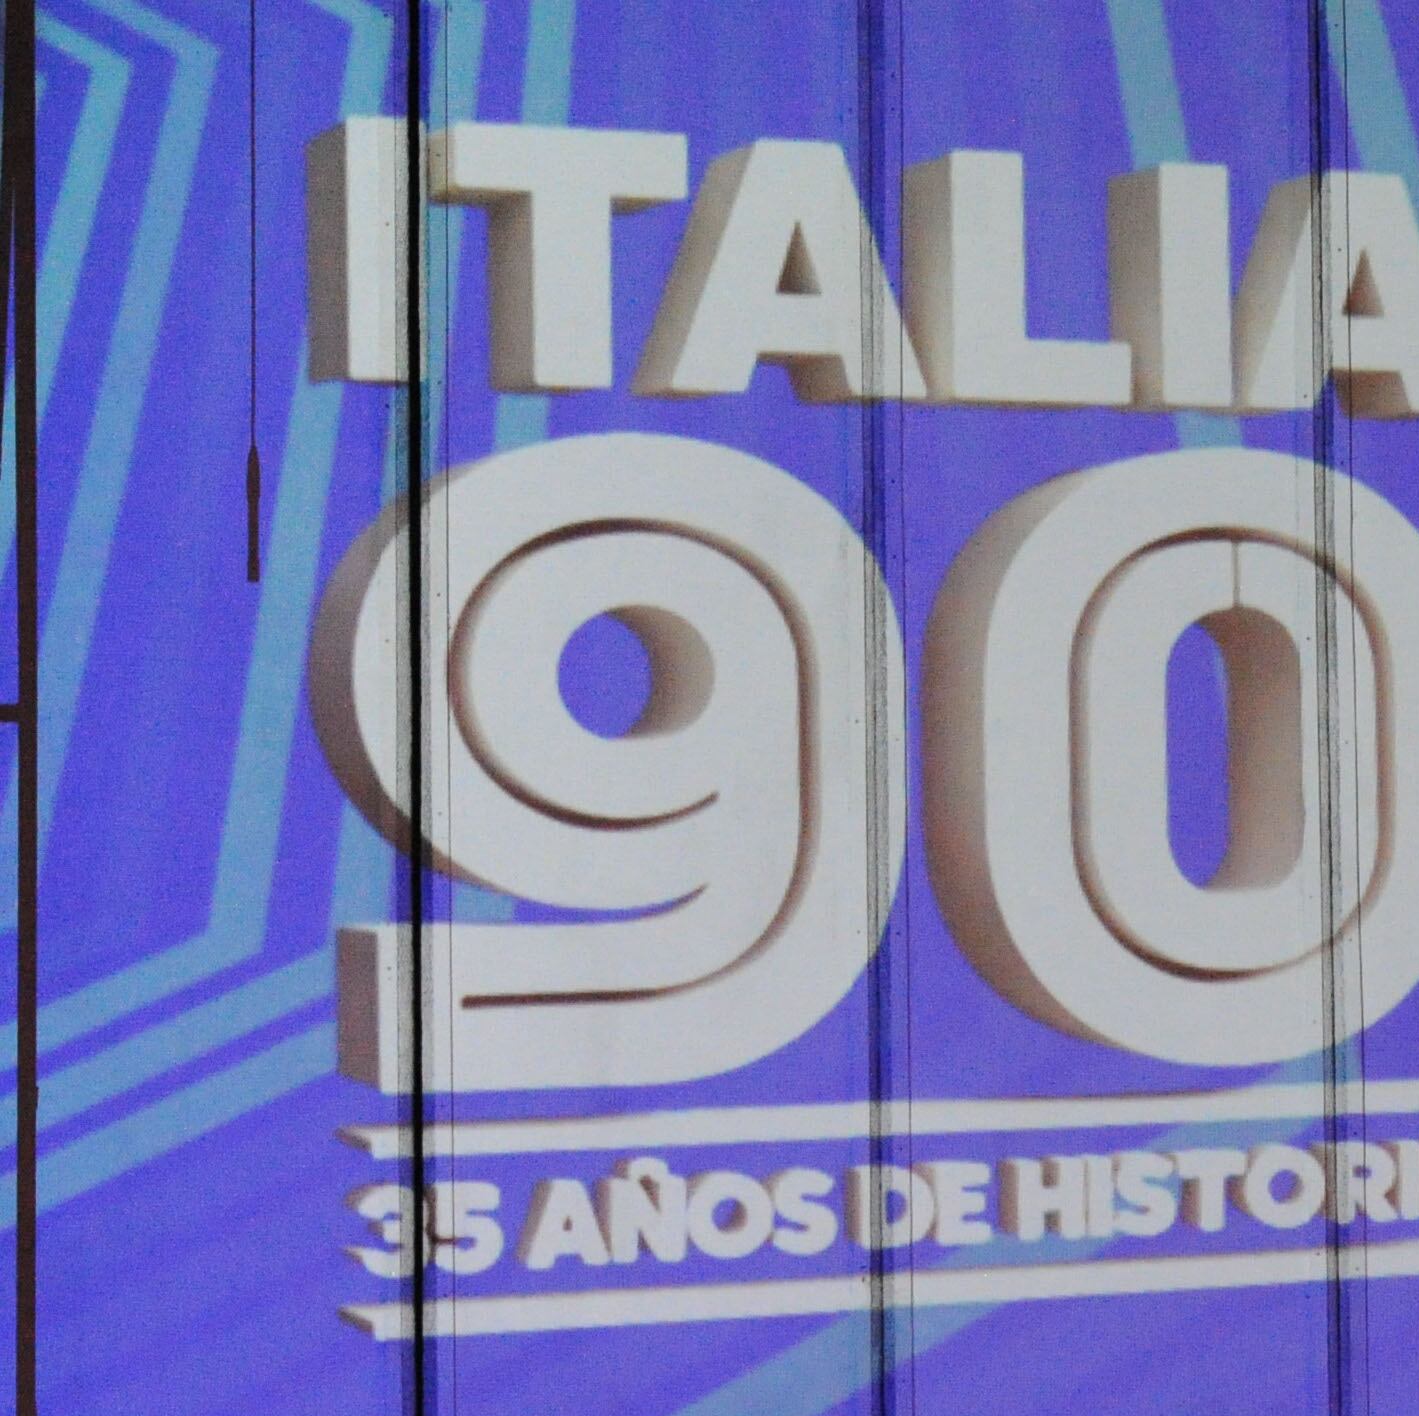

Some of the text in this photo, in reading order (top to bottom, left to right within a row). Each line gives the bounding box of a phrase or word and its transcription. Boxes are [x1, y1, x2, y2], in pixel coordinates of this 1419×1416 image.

[345, 1180, 504, 1279] 35
[517, 1157, 838, 1270] AÑOS
[845, 1160, 993, 1250] DE
